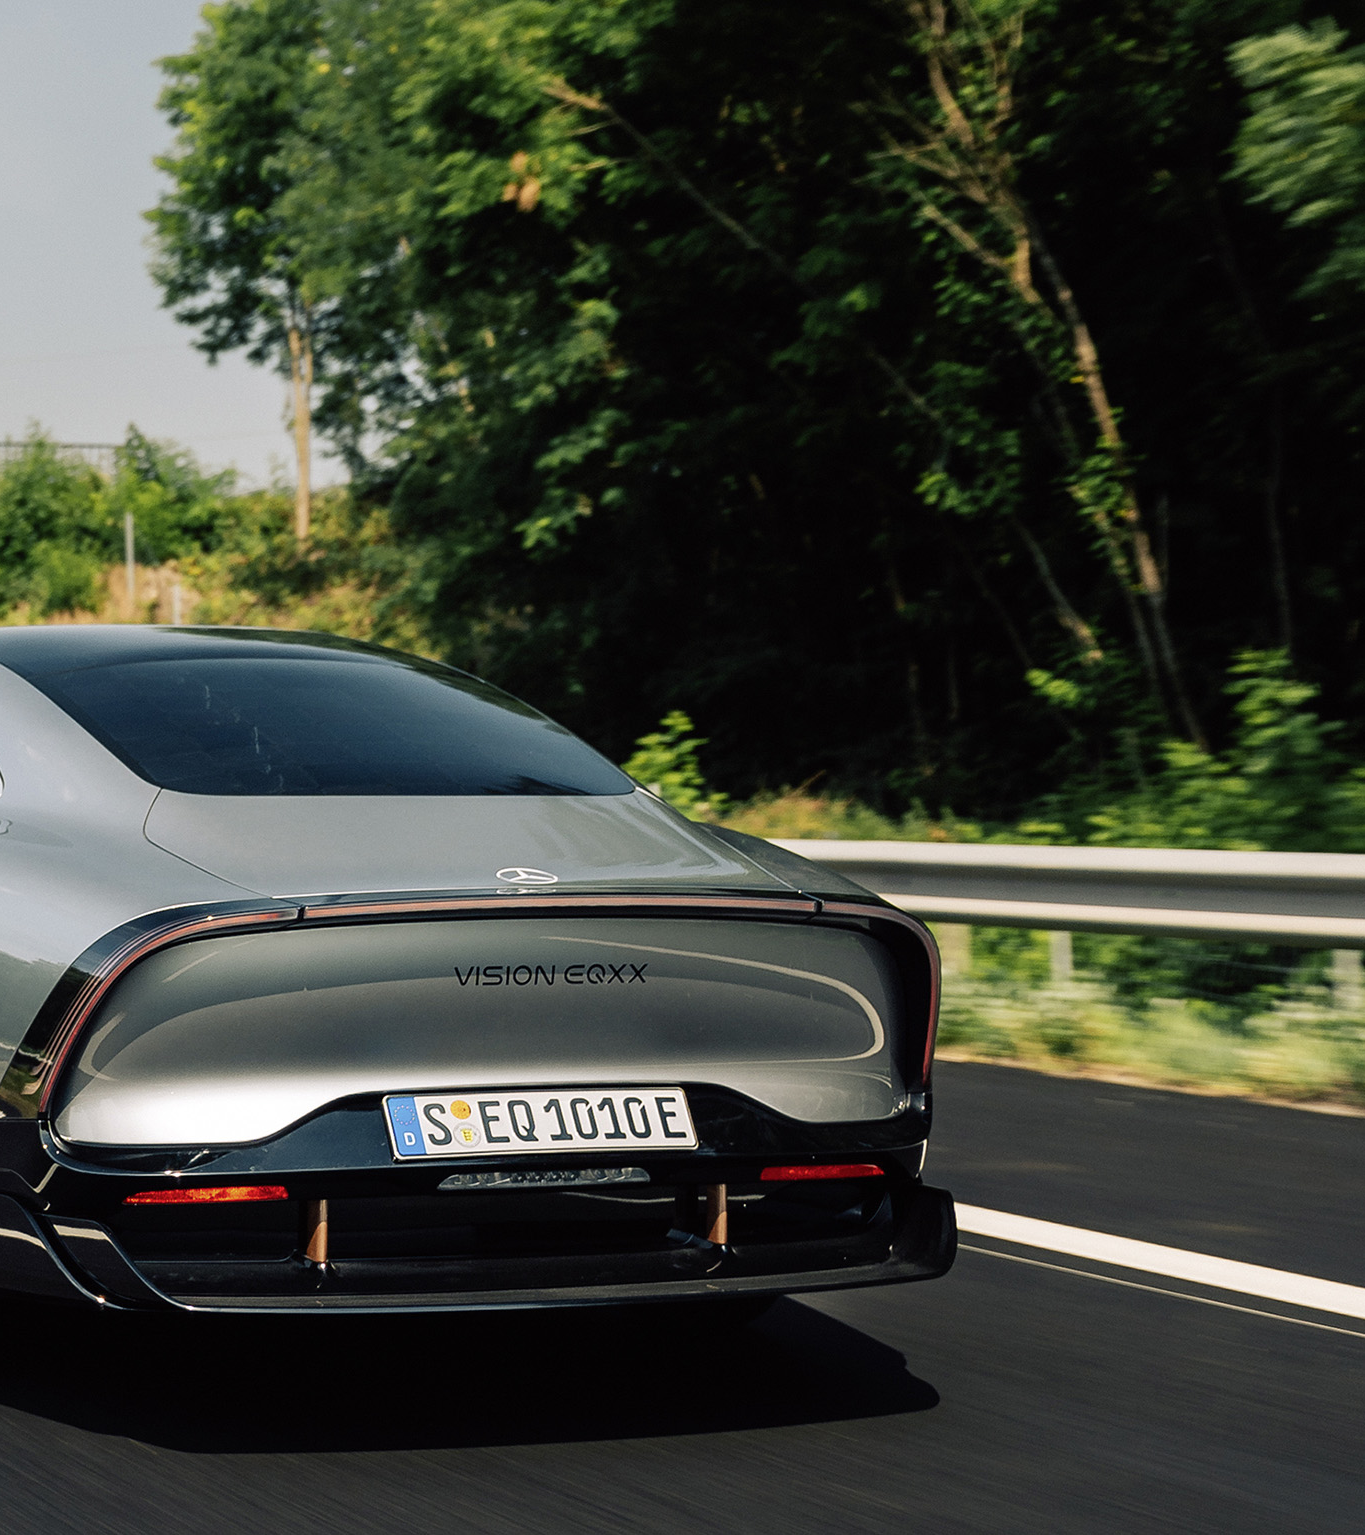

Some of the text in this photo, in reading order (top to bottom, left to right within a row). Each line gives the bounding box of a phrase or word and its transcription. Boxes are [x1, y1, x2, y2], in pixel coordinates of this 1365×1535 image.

[454, 963, 648, 986] VISION EQXX
[404, 1132, 416, 1146] D
